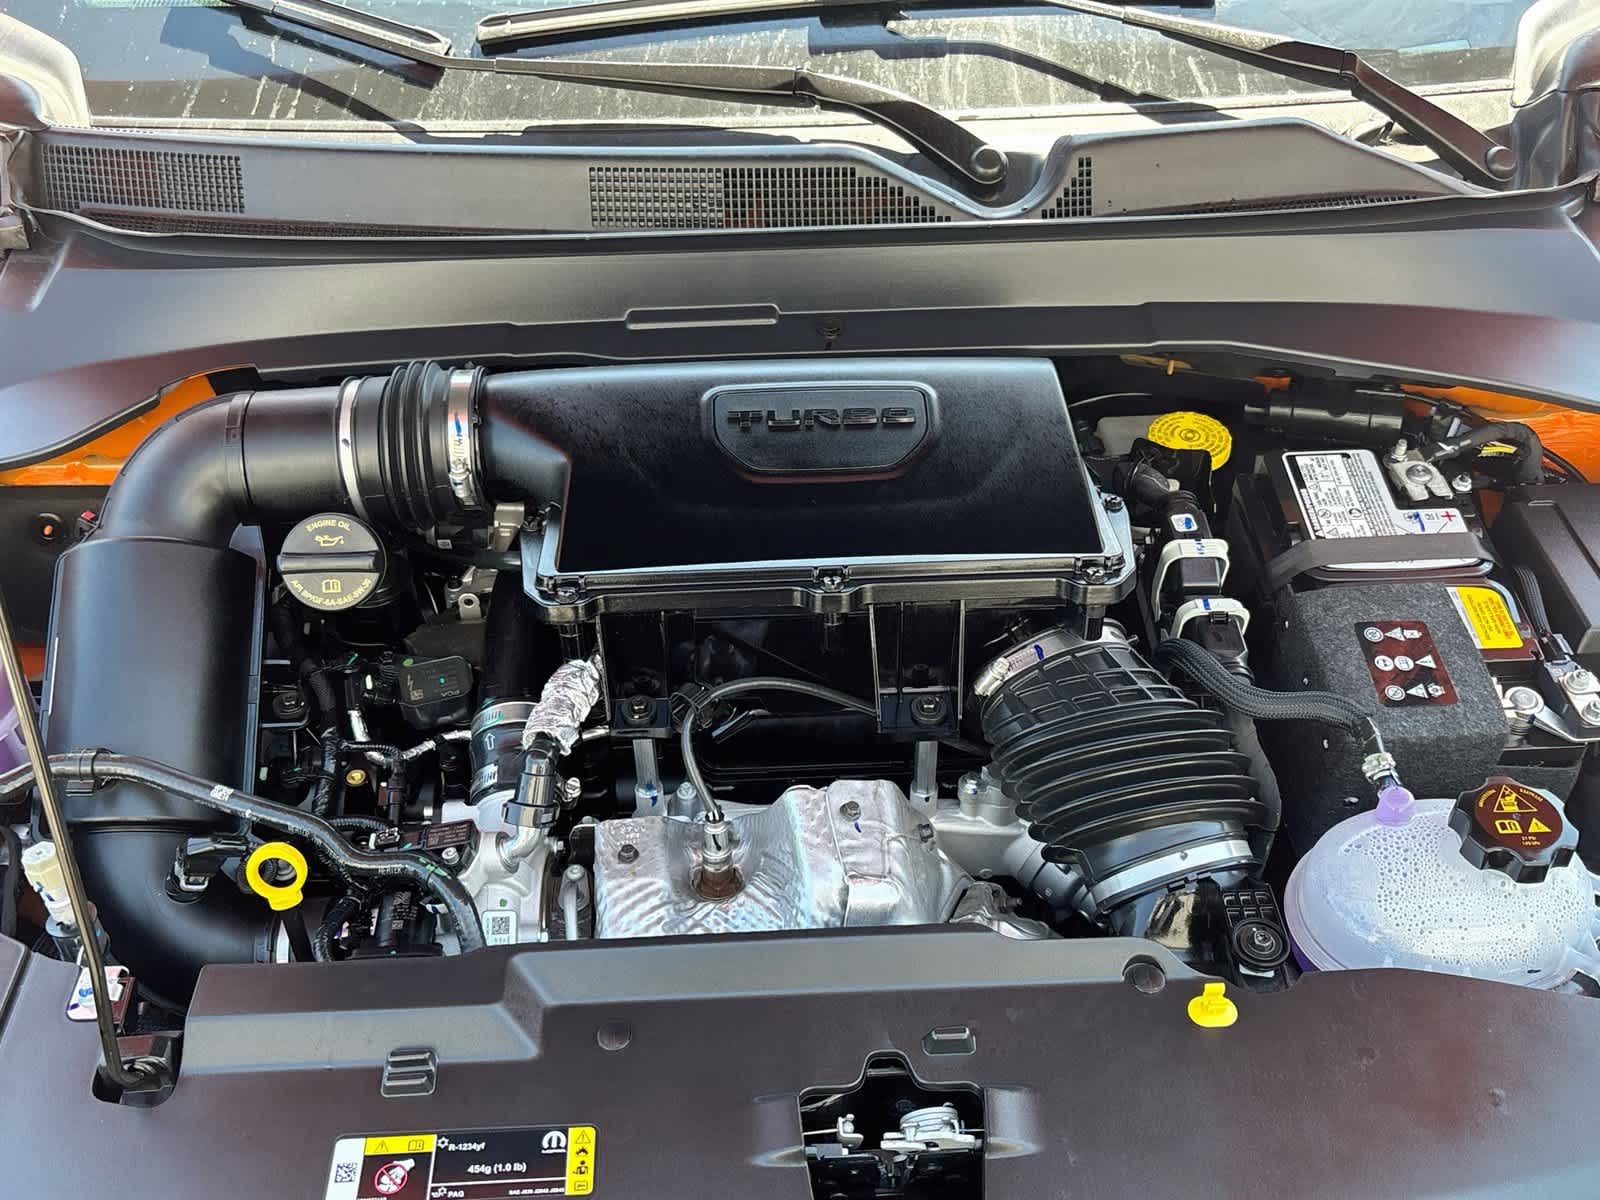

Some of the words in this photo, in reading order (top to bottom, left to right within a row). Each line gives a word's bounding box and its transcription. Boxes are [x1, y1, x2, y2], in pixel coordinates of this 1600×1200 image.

[728, 407, 916, 432] TURBO
[305, 519, 337, 532] ENGINE
[337, 520, 352, 532] OIL
[448, 1141, 486, 1152] R-1234yf
[467, 1165, 493, 1175] 454g
[493, 1163, 512, 1174] (1.0
[513, 1162, 527, 1173] lb)
[447, 1190, 465, 1199] PAG
